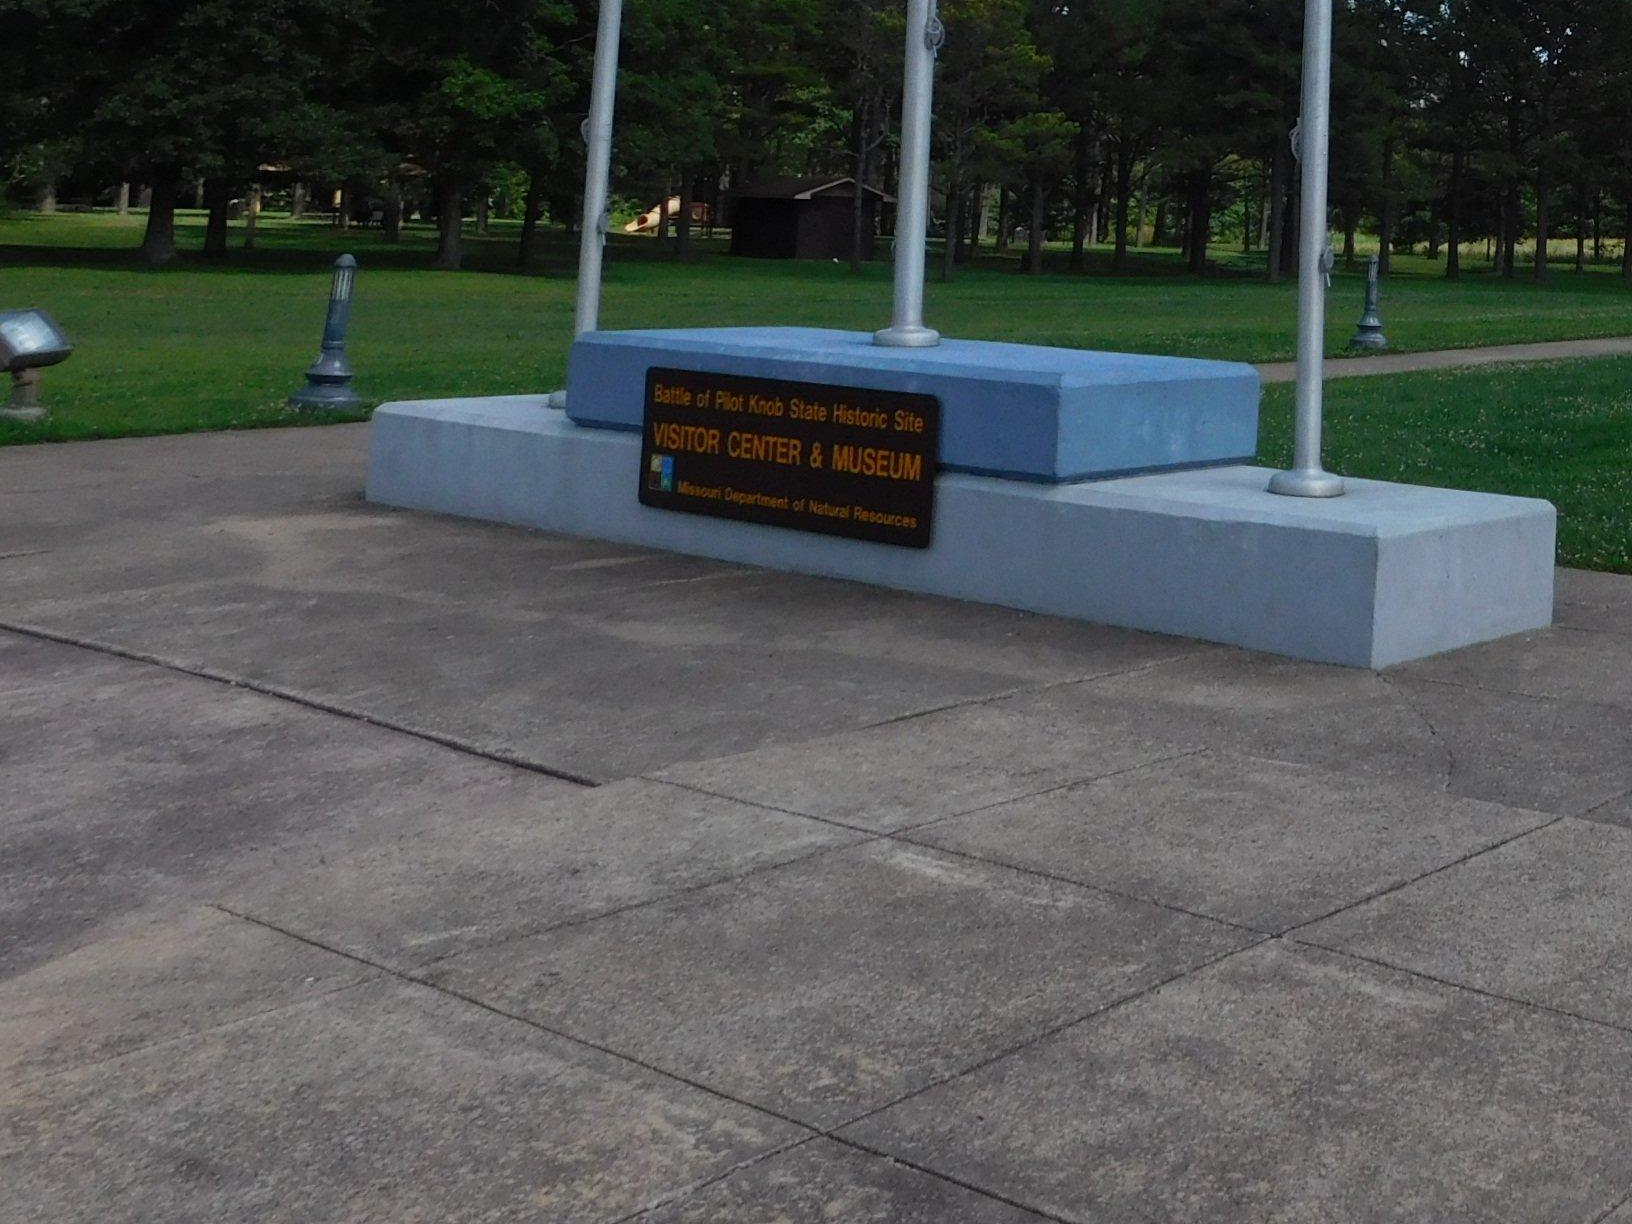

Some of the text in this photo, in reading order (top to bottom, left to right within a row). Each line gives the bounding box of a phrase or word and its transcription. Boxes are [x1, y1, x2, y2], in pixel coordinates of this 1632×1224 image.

[654, 384, 924, 433] Battle of Pilot Knob State Historic Site
[653, 422, 922, 481] VISITOR CENTER & MUSEUM
[677, 480, 918, 529] Missouri Department of Natural Resources
